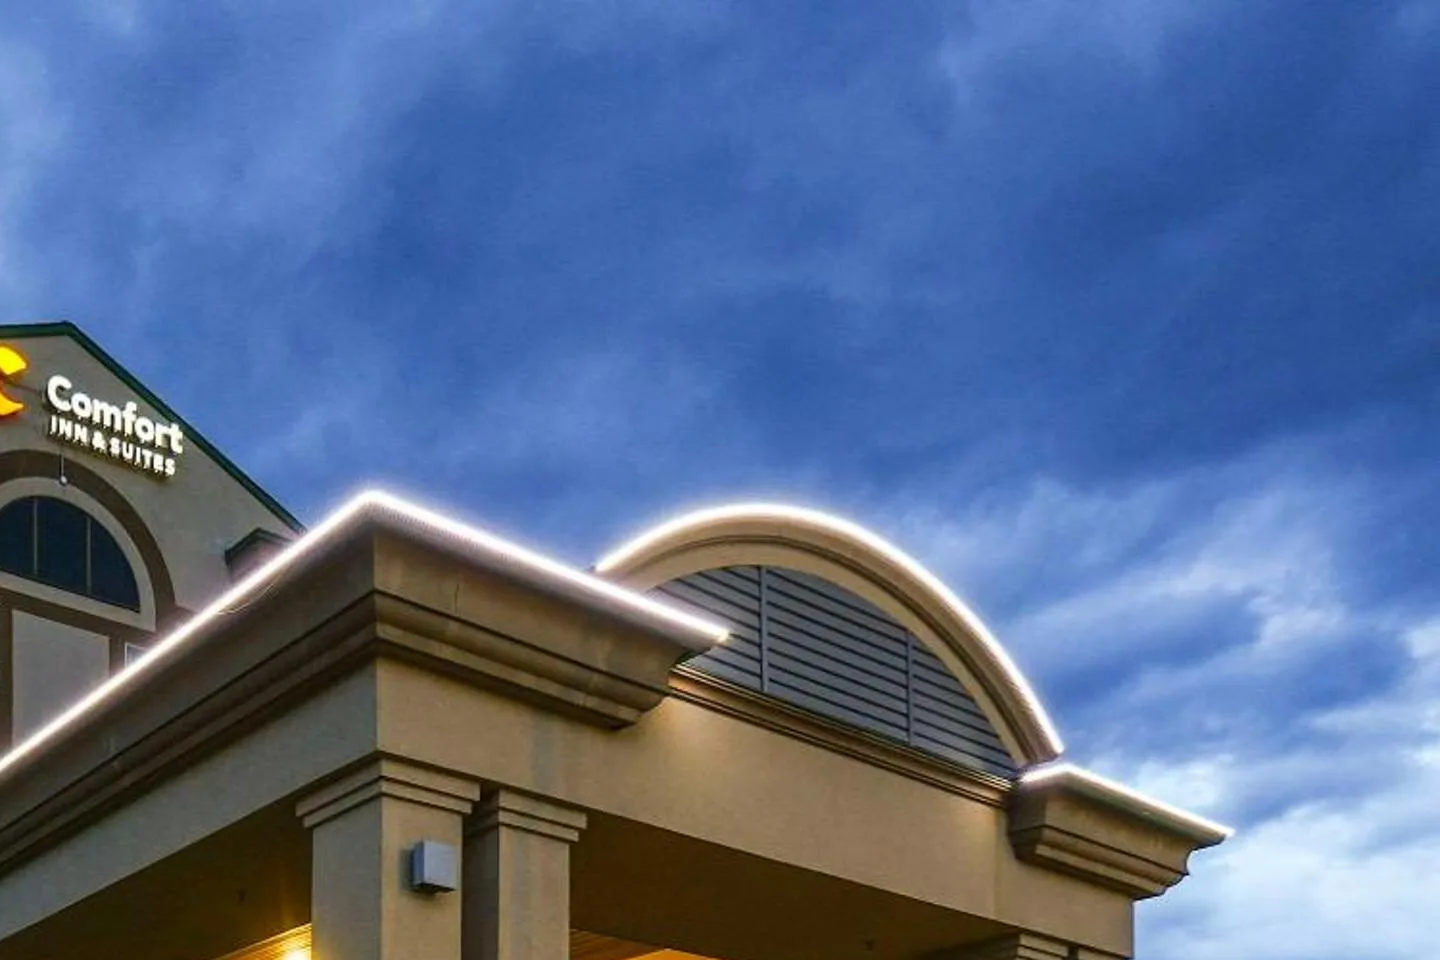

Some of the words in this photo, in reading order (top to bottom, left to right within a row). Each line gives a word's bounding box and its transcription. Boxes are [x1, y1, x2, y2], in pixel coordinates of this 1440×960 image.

[47, 374, 183, 454] Comfort
[49, 415, 88, 446] INN
[109, 437, 176, 477] SUITES
